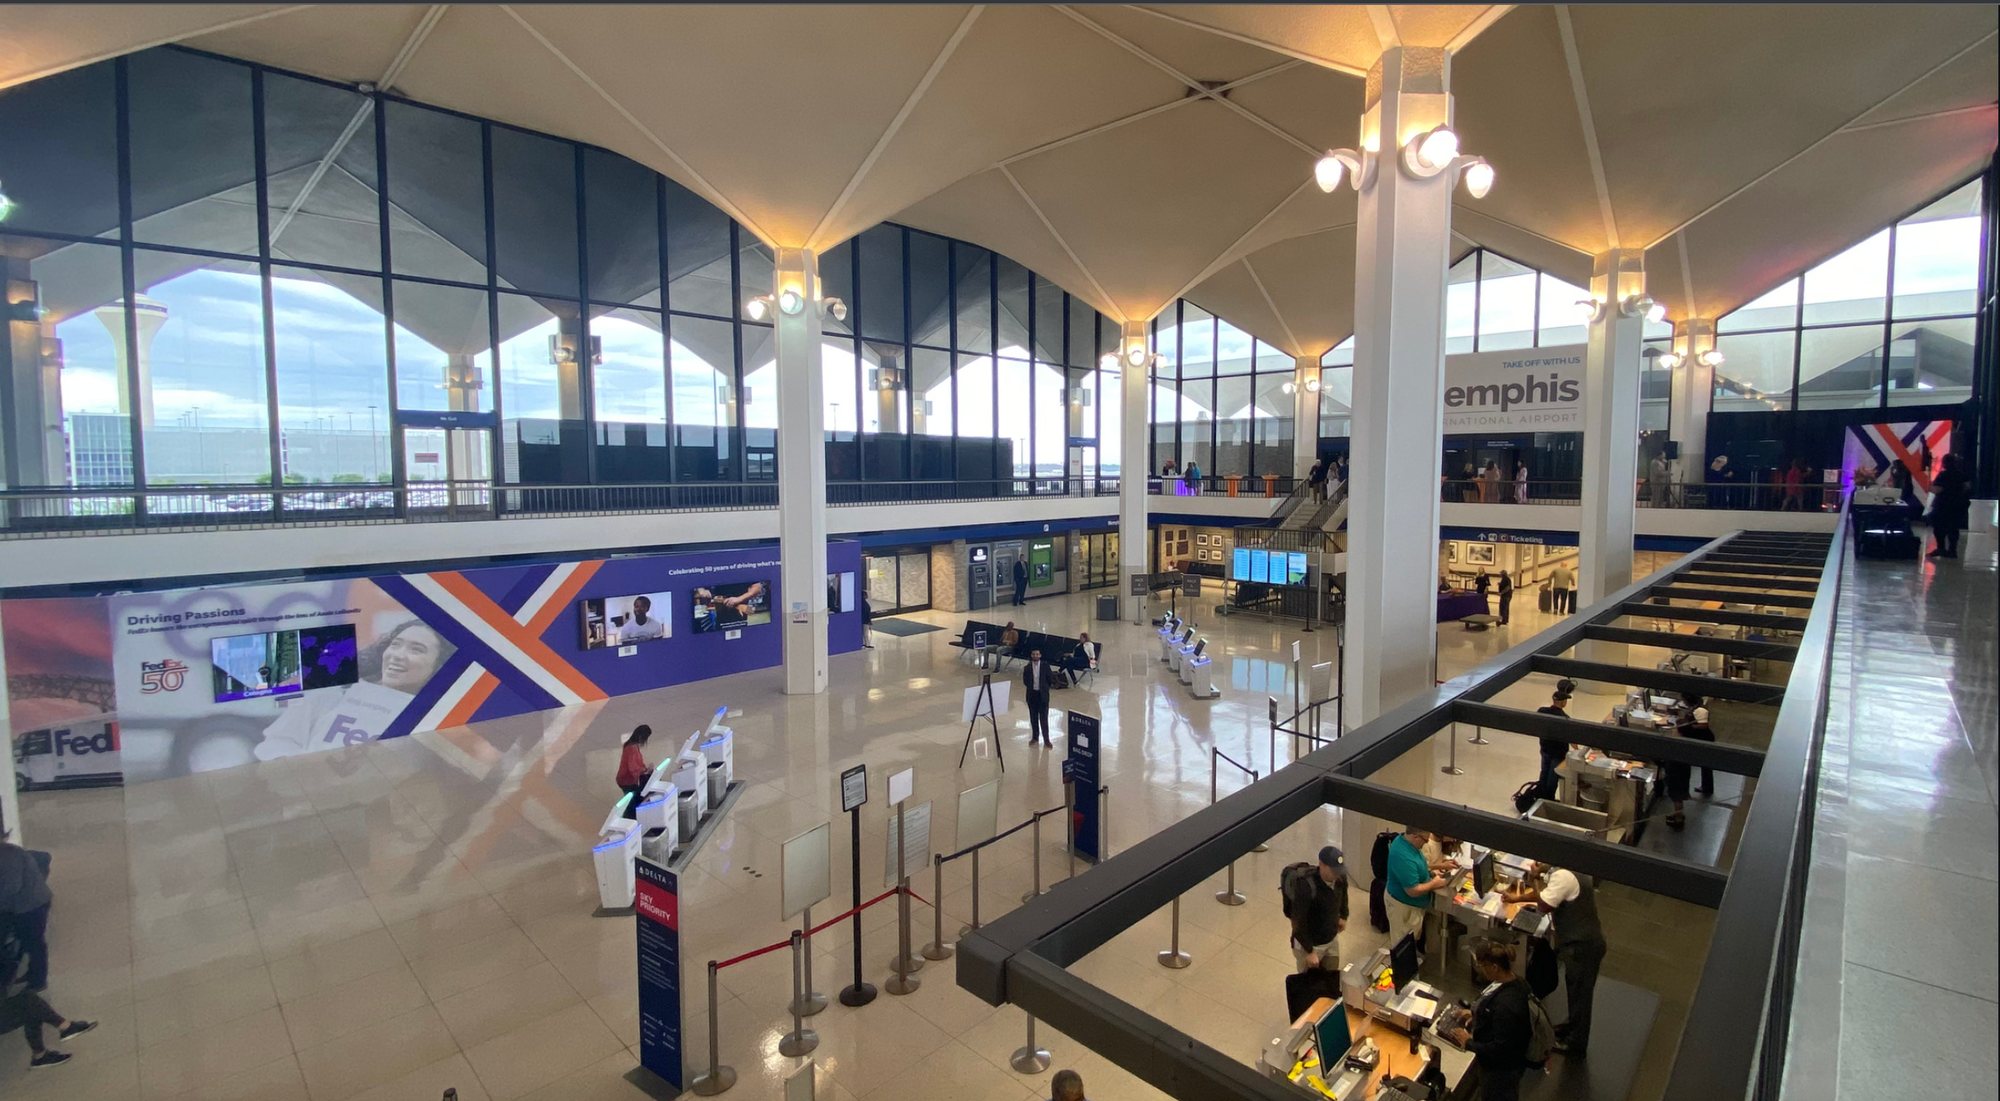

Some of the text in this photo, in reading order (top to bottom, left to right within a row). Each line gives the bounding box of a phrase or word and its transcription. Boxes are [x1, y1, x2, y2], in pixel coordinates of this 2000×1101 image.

[1502, 356, 1581, 369] TAKE OFF WITH US
[1520, 413, 1578, 424] AIRPORT
[1510, 535, 1543, 544] Ticketing
[668, 566, 704, 576] Celebrating
[713, 565, 729, 573] years
[127, 607, 246, 626] Driving Passions
[141, 658, 183, 671] FedEx
[141, 669, 185, 695] 50
[644, 868, 667, 884] DELTA
[640, 892, 654, 903] SKY
[640, 900, 671, 921] PRIORITY
